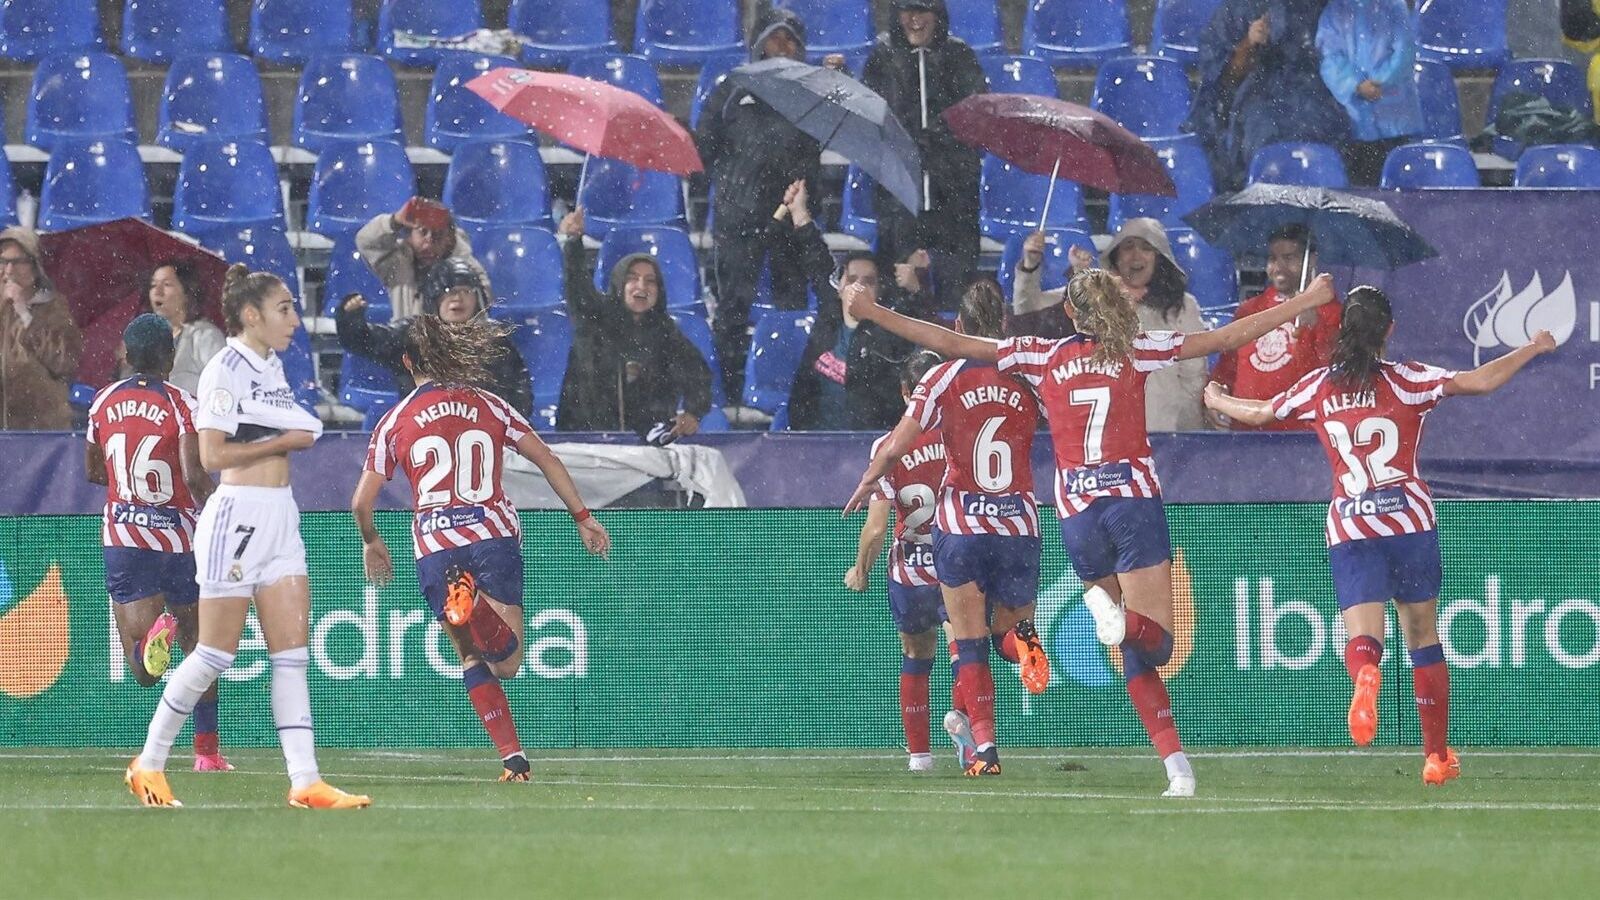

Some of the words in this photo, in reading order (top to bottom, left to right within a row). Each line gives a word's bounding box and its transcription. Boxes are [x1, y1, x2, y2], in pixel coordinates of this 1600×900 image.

[1051, 356, 1124, 385] MAITANE
[106, 399, 169, 427] AJIBADE
[959, 386, 1007, 410] IRENE
[1007, 391, 1023, 412] G.
[1322, 389, 1376, 418] ALEXIA
[413, 401, 479, 430] MEDINA
[1069, 386, 1111, 465] 7
[105, 432, 174, 506] 16
[973, 415, 1013, 494] 6
[1323, 416, 1409, 497] 32
[410, 429, 495, 510] 20
[968, 495, 999, 516] ria
[1344, 495, 1376, 517] ria
[1377, 496, 1400, 505] Money
[1377, 504, 1404, 513] Transfer
[117, 505, 148, 526] ria
[421, 512, 451, 534] ria
[234, 524, 256, 561] 7
[1234, 575, 1600, 671] Ibdro
